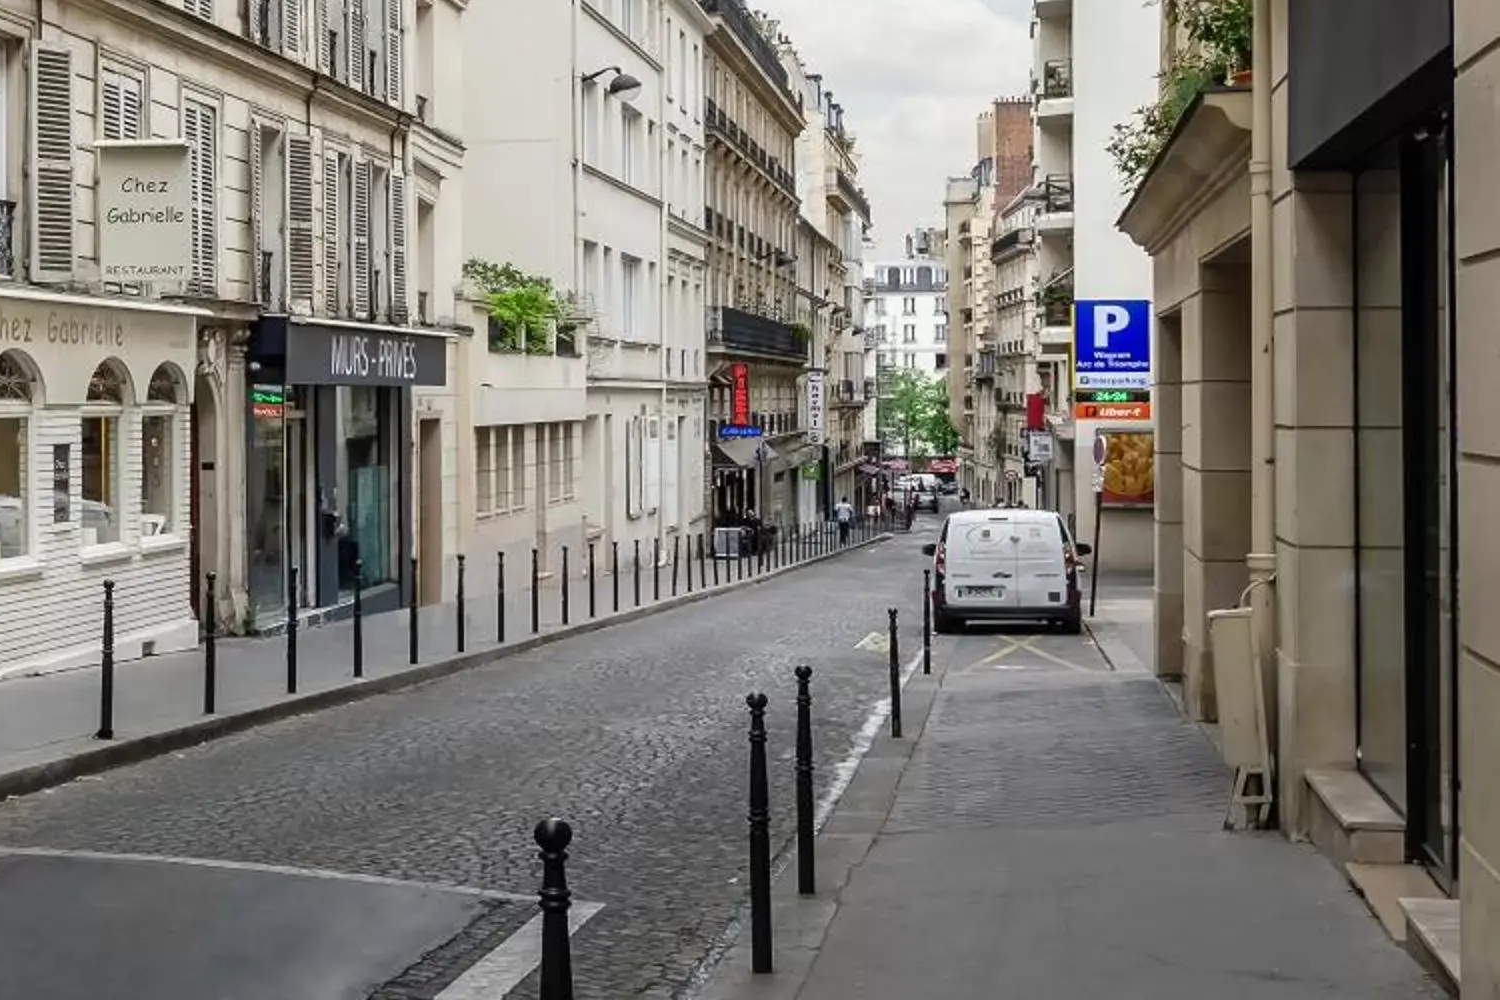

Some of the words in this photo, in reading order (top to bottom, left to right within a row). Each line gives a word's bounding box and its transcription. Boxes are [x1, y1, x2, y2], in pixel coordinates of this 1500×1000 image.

[121, 177, 169, 193] Chez
[107, 206, 185, 224] Gabrielle
[105, 264, 185, 276] RESTAURANT
[47, 311, 124, 347] Gabrielle
[1093, 305, 1131, 349] P
[331, 335, 369, 377] MURS
[378, 336, 418, 379] PRIVÉS
